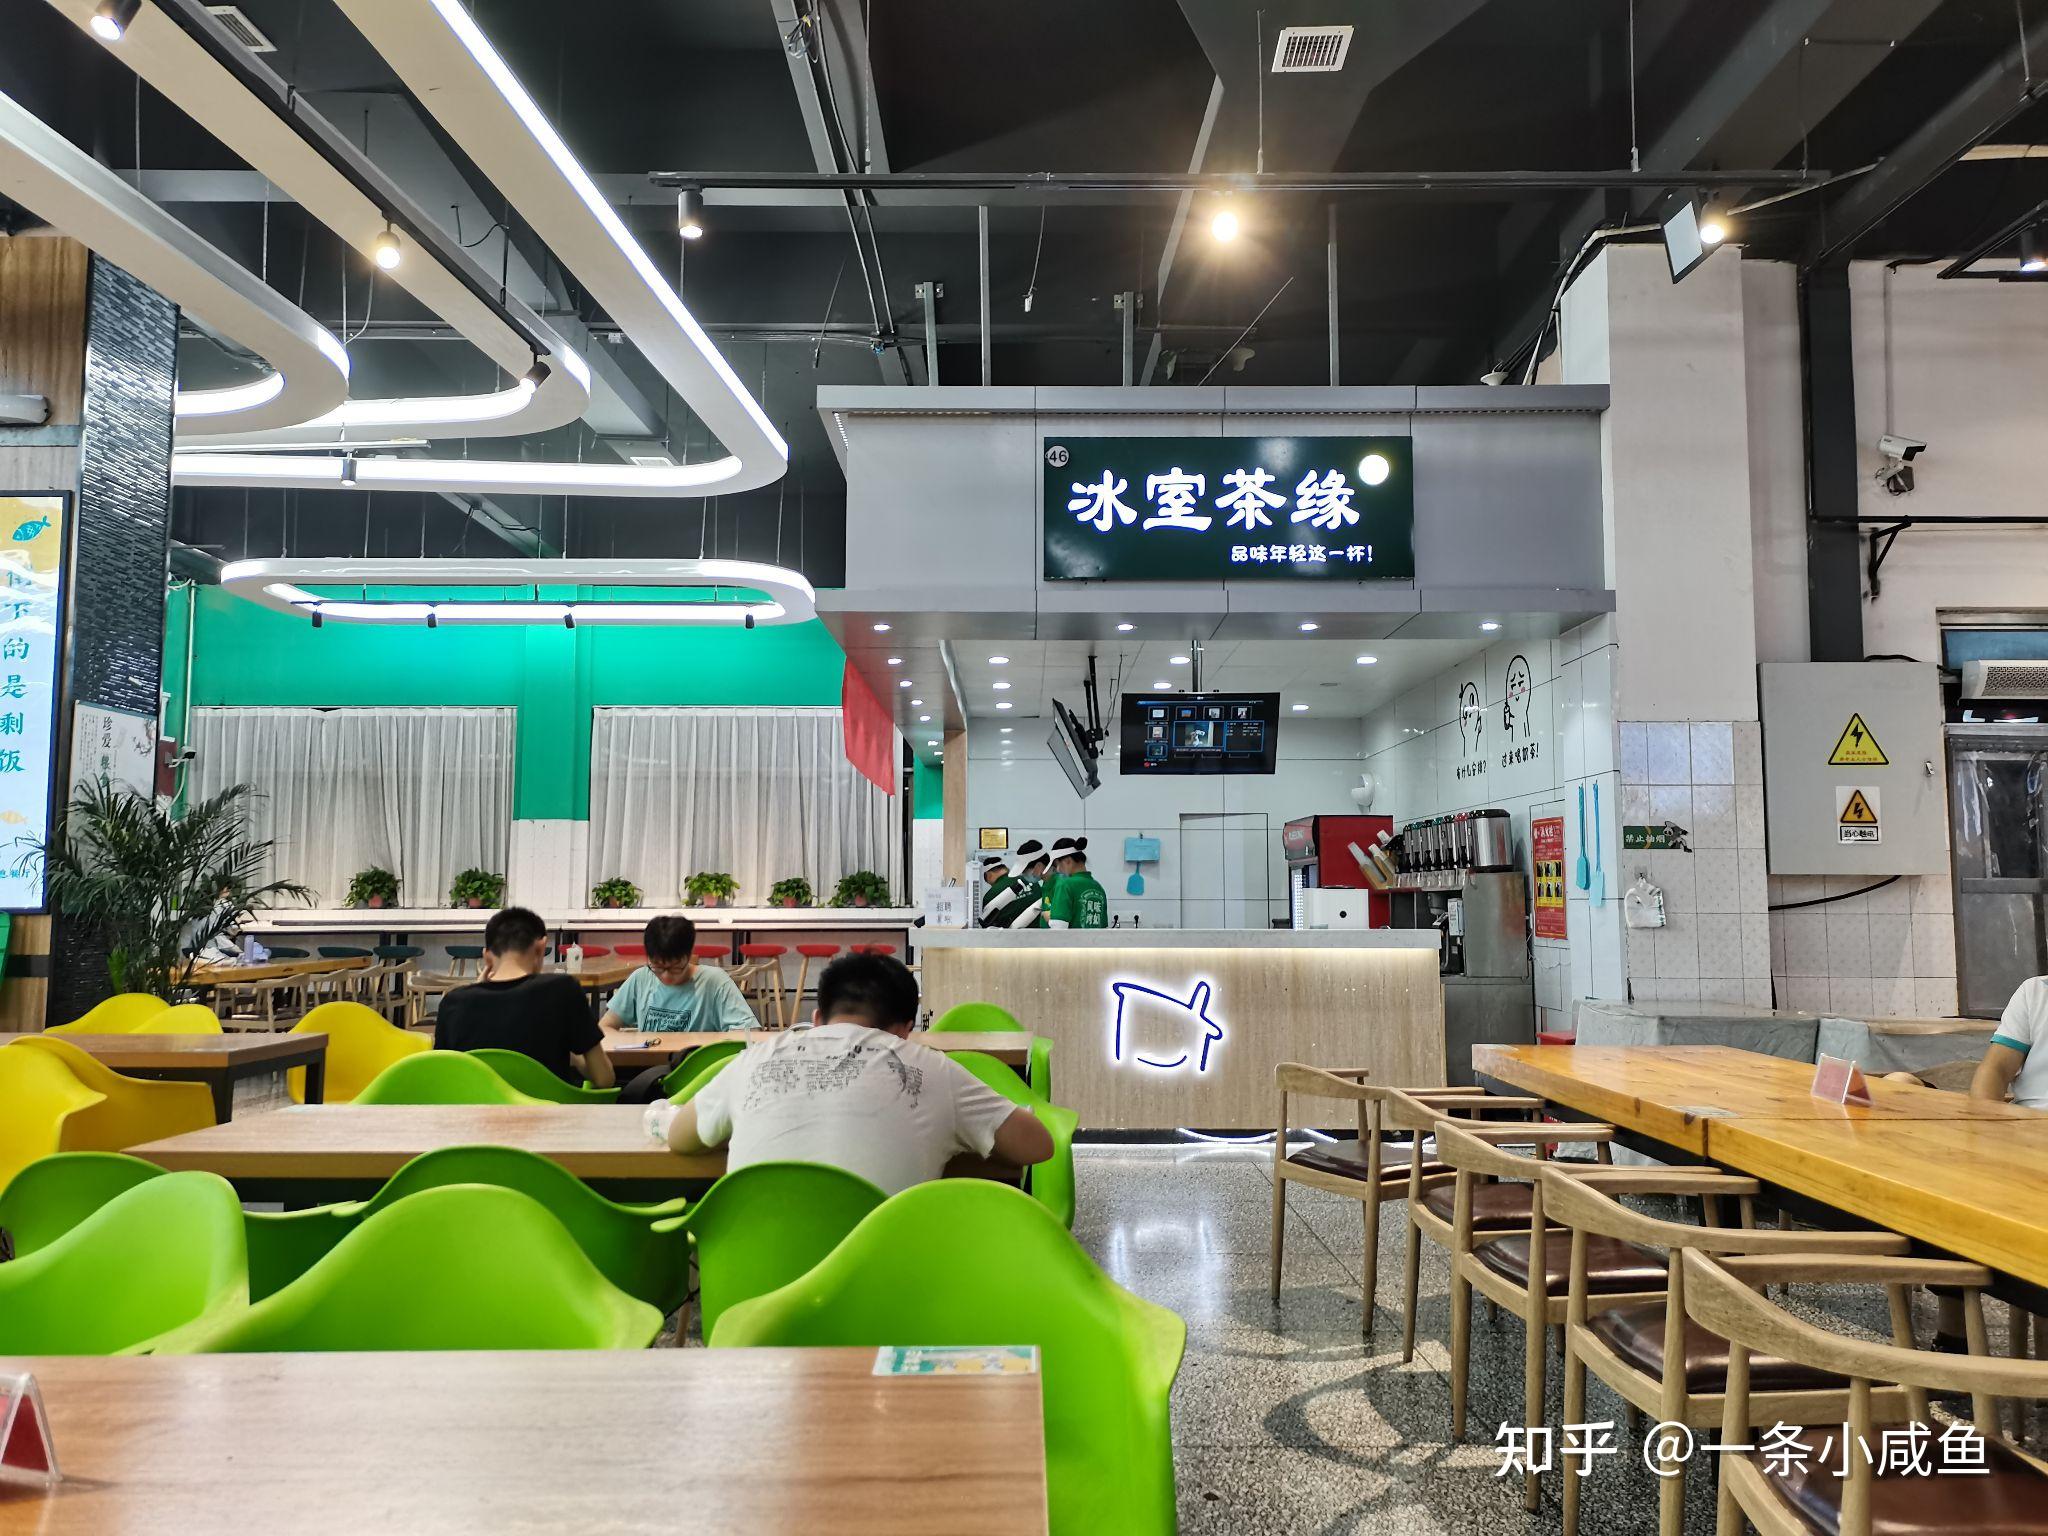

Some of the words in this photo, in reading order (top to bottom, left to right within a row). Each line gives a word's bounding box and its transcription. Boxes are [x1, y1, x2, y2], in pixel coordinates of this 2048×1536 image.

[1049, 450, 1068, 463] 46
[1067, 466, 1361, 533] 冰室茶缘
